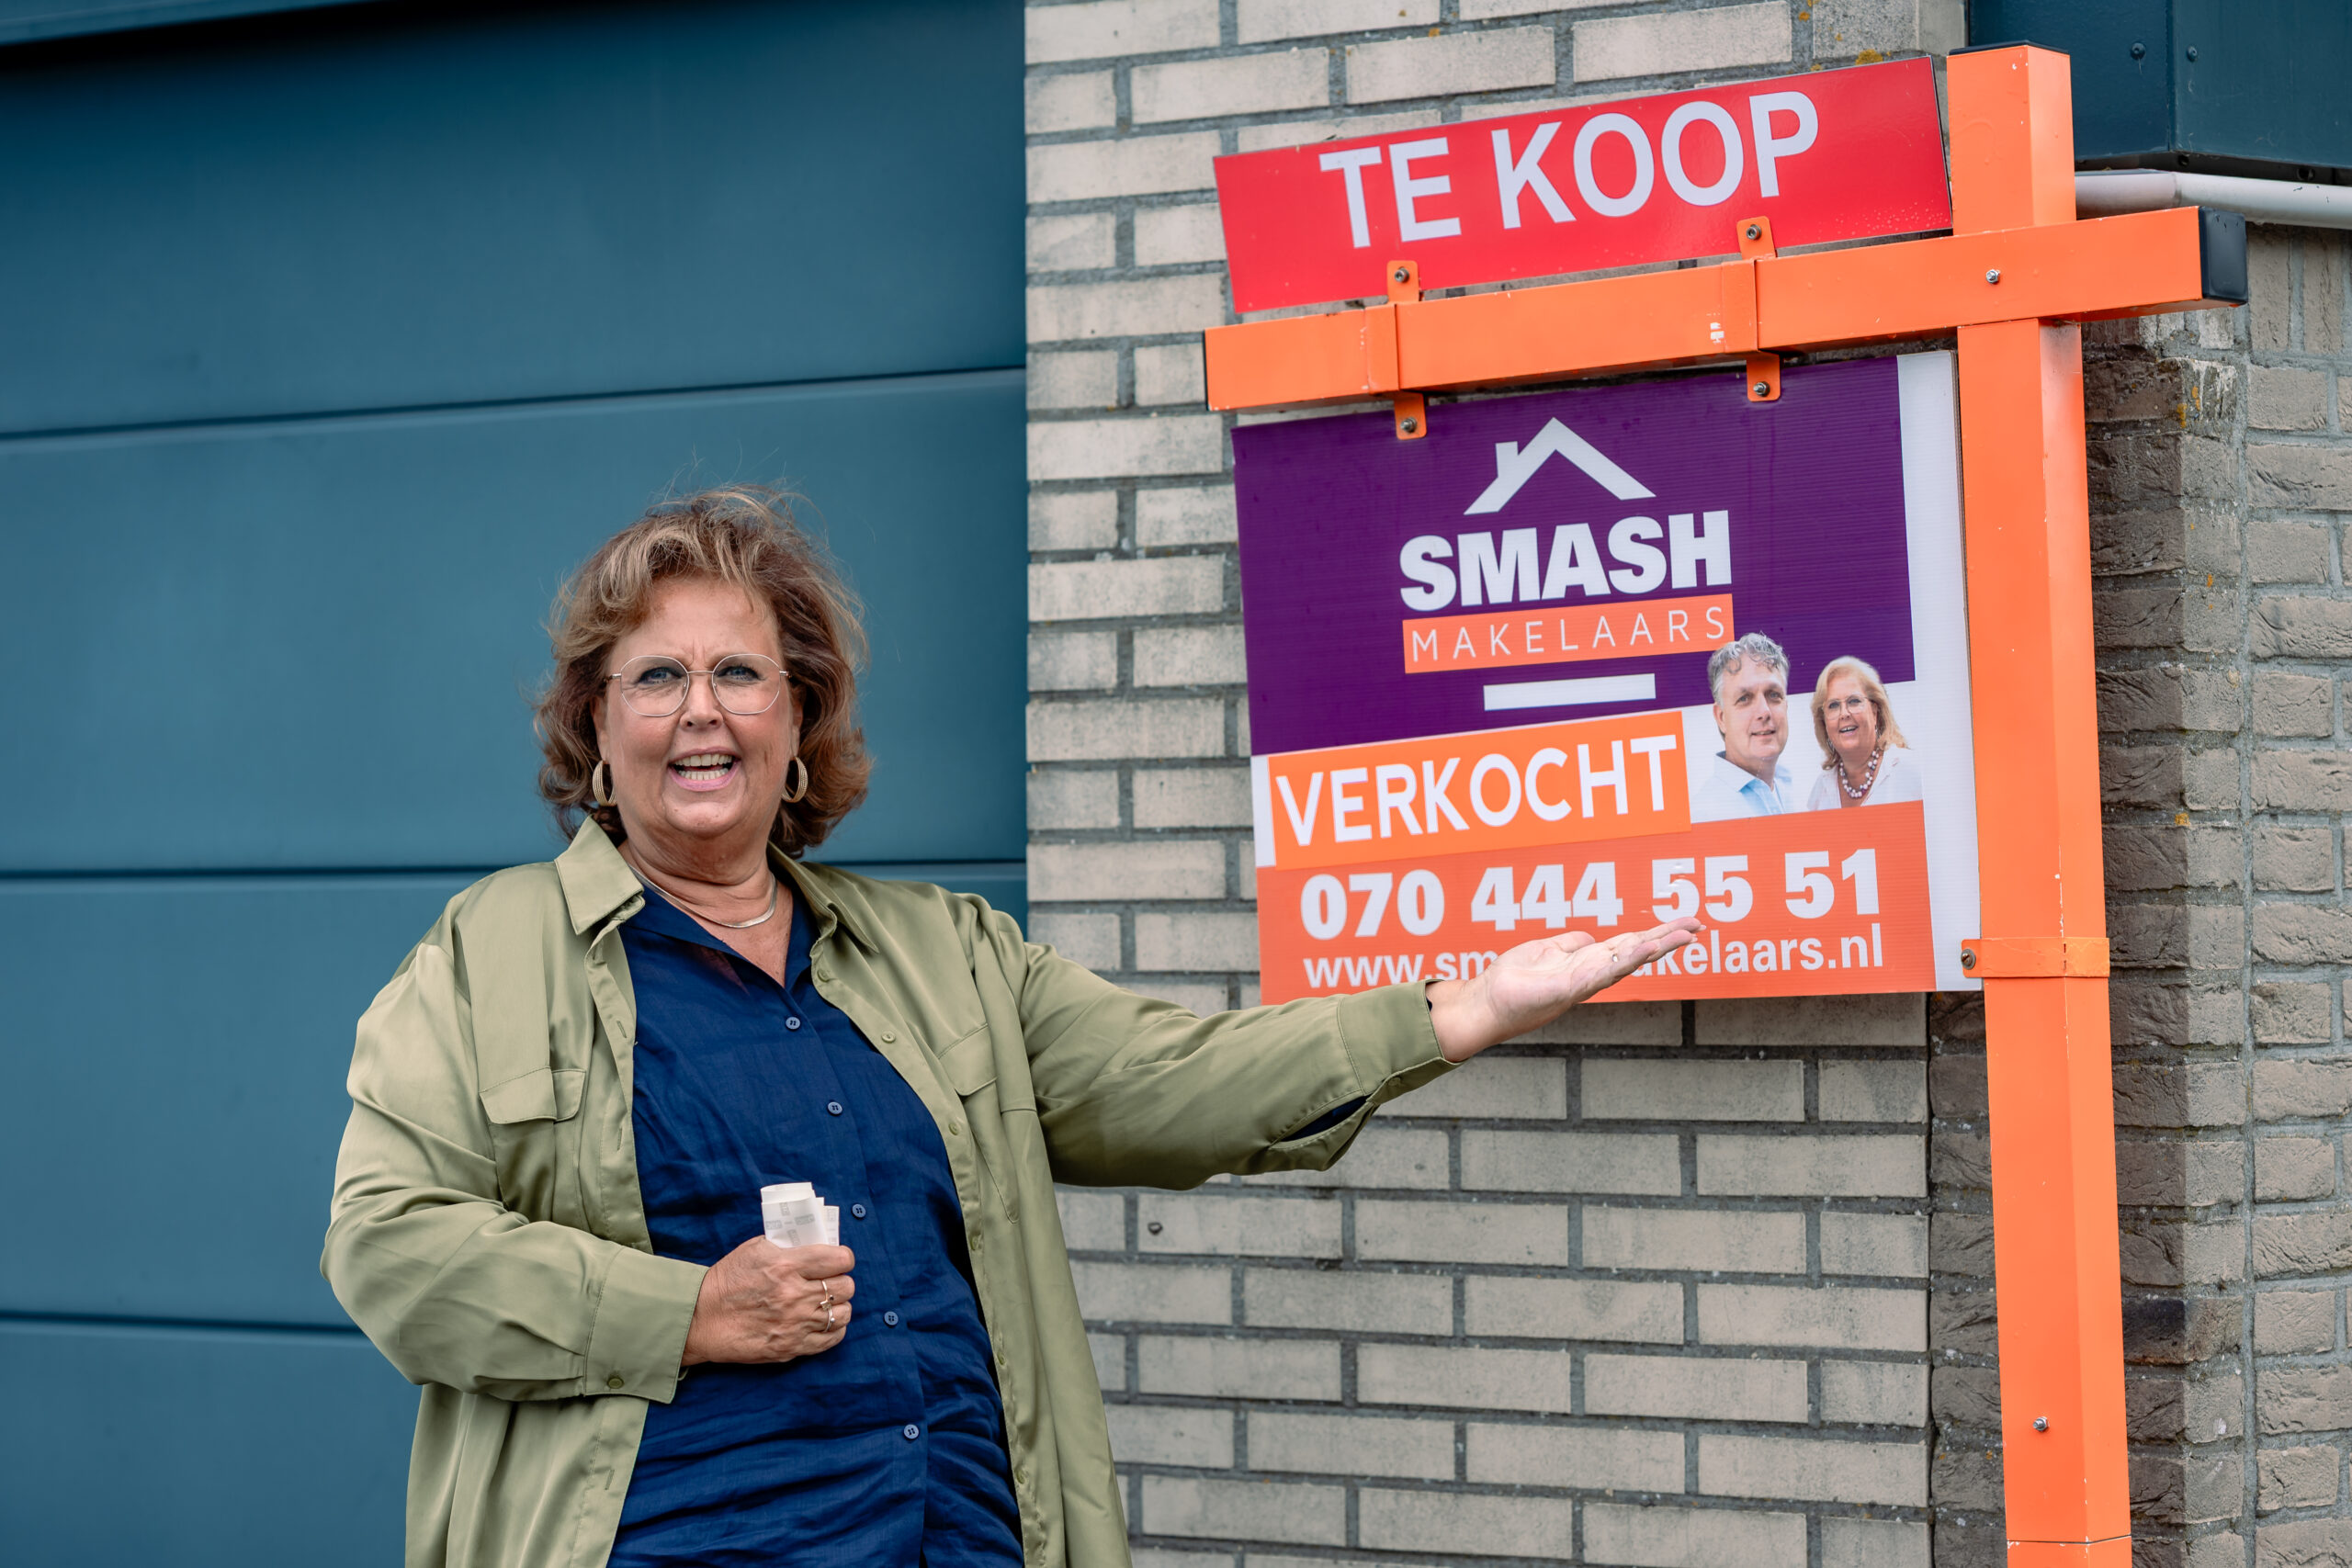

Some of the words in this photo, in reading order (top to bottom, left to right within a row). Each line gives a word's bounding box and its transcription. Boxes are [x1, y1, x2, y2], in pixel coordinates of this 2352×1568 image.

[1319, 137, 1462, 248] TE
[1491, 90, 1820, 230] KOOP
[1399, 509, 1733, 612] SMASH
[1411, 605, 1726, 663] MAKELAARS
[1275, 734, 1678, 847] VERKOCHT
[1300, 869, 1445, 941] 070
[1470, 861, 1624, 931] 444
[1651, 854, 1754, 924] 55
[1784, 848, 1880, 919] 51
